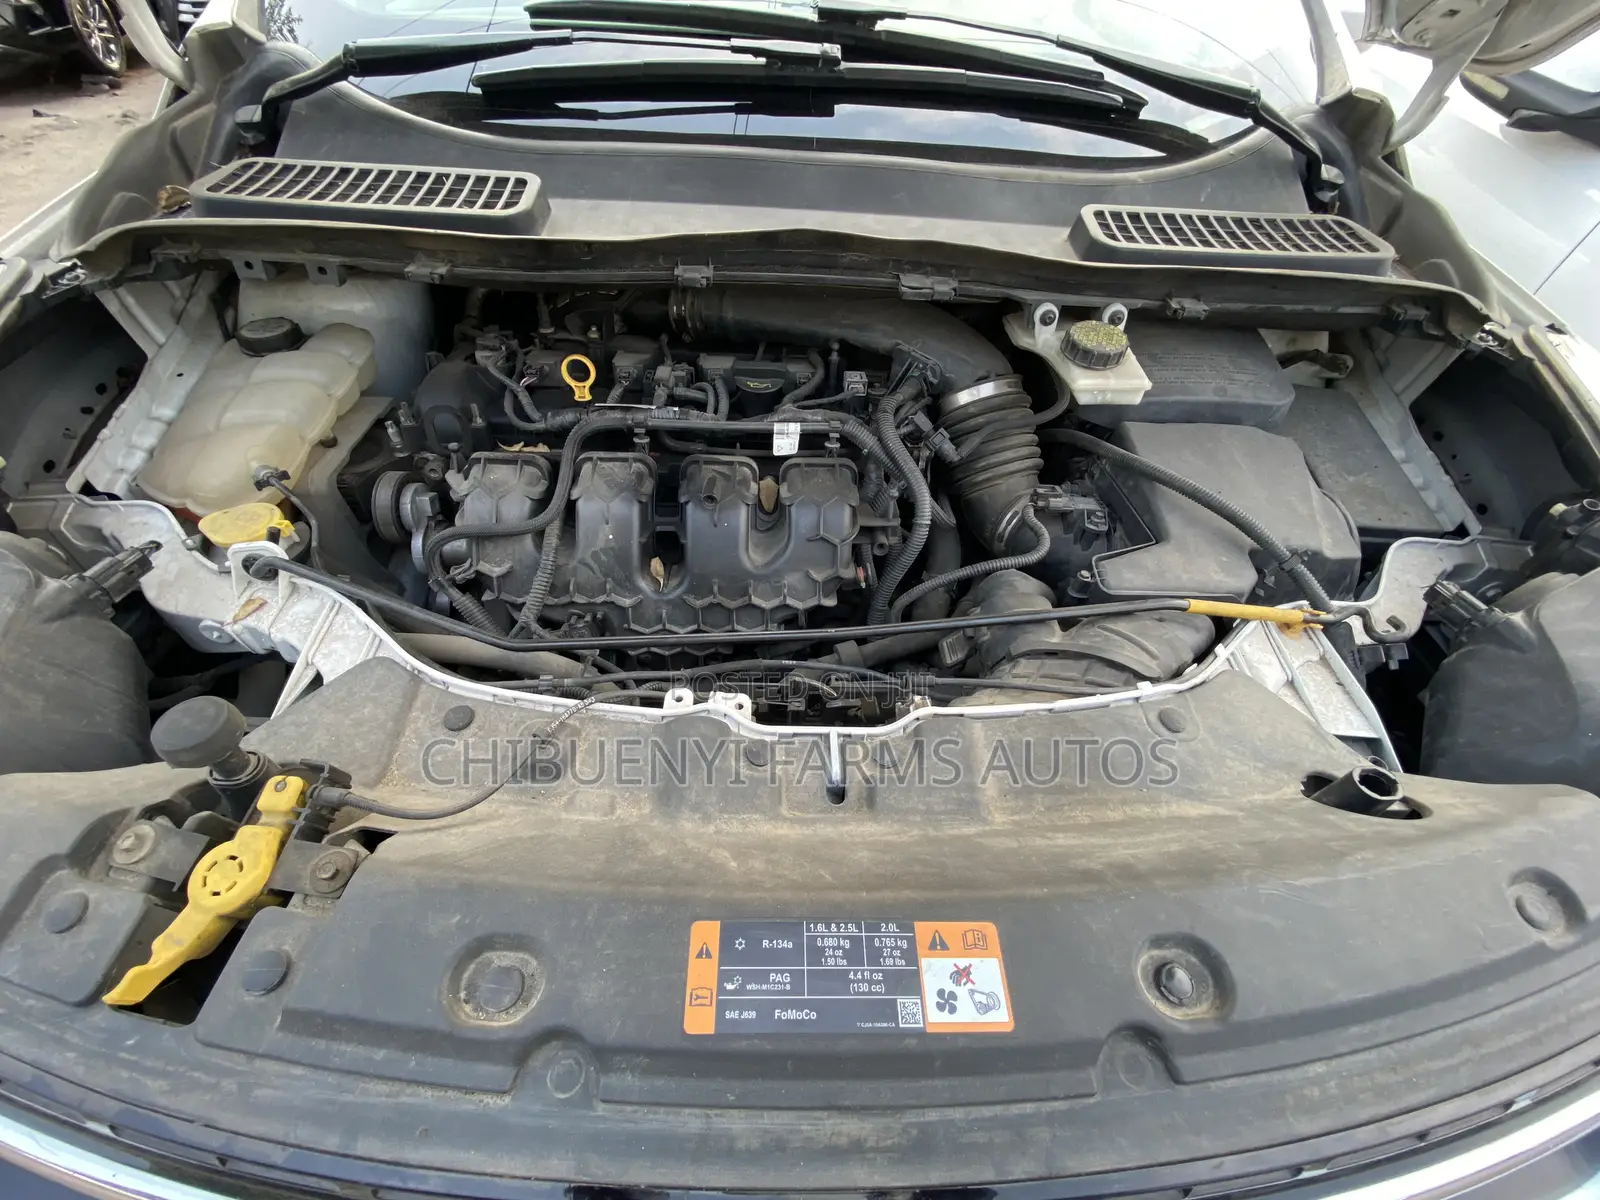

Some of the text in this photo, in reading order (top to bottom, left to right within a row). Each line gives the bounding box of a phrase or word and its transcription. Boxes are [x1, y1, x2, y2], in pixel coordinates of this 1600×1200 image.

[809, 923, 859, 932] 1.6L & 2.5L
[881, 923, 900, 932] 2.0L
[762, 939, 793, 949] R-134a
[816, 937, 850, 949] 0.680 kg
[874, 937, 908, 949] 0.765 kg
[824, 948, 834, 956] 24
[882, 948, 891, 956] 27
[821, 958, 847, 966] 1.50 lbs
[894, 958, 906, 966] lbs
[769, 973, 791, 982] PAG
[848, 971, 862, 980] 4.4
[863, 971, 870, 980] fl
[850, 983, 885, 994] (130 cc)
[725, 1010, 756, 1019] SAE J639
[774, 1009, 817, 1020] FoMoCo
